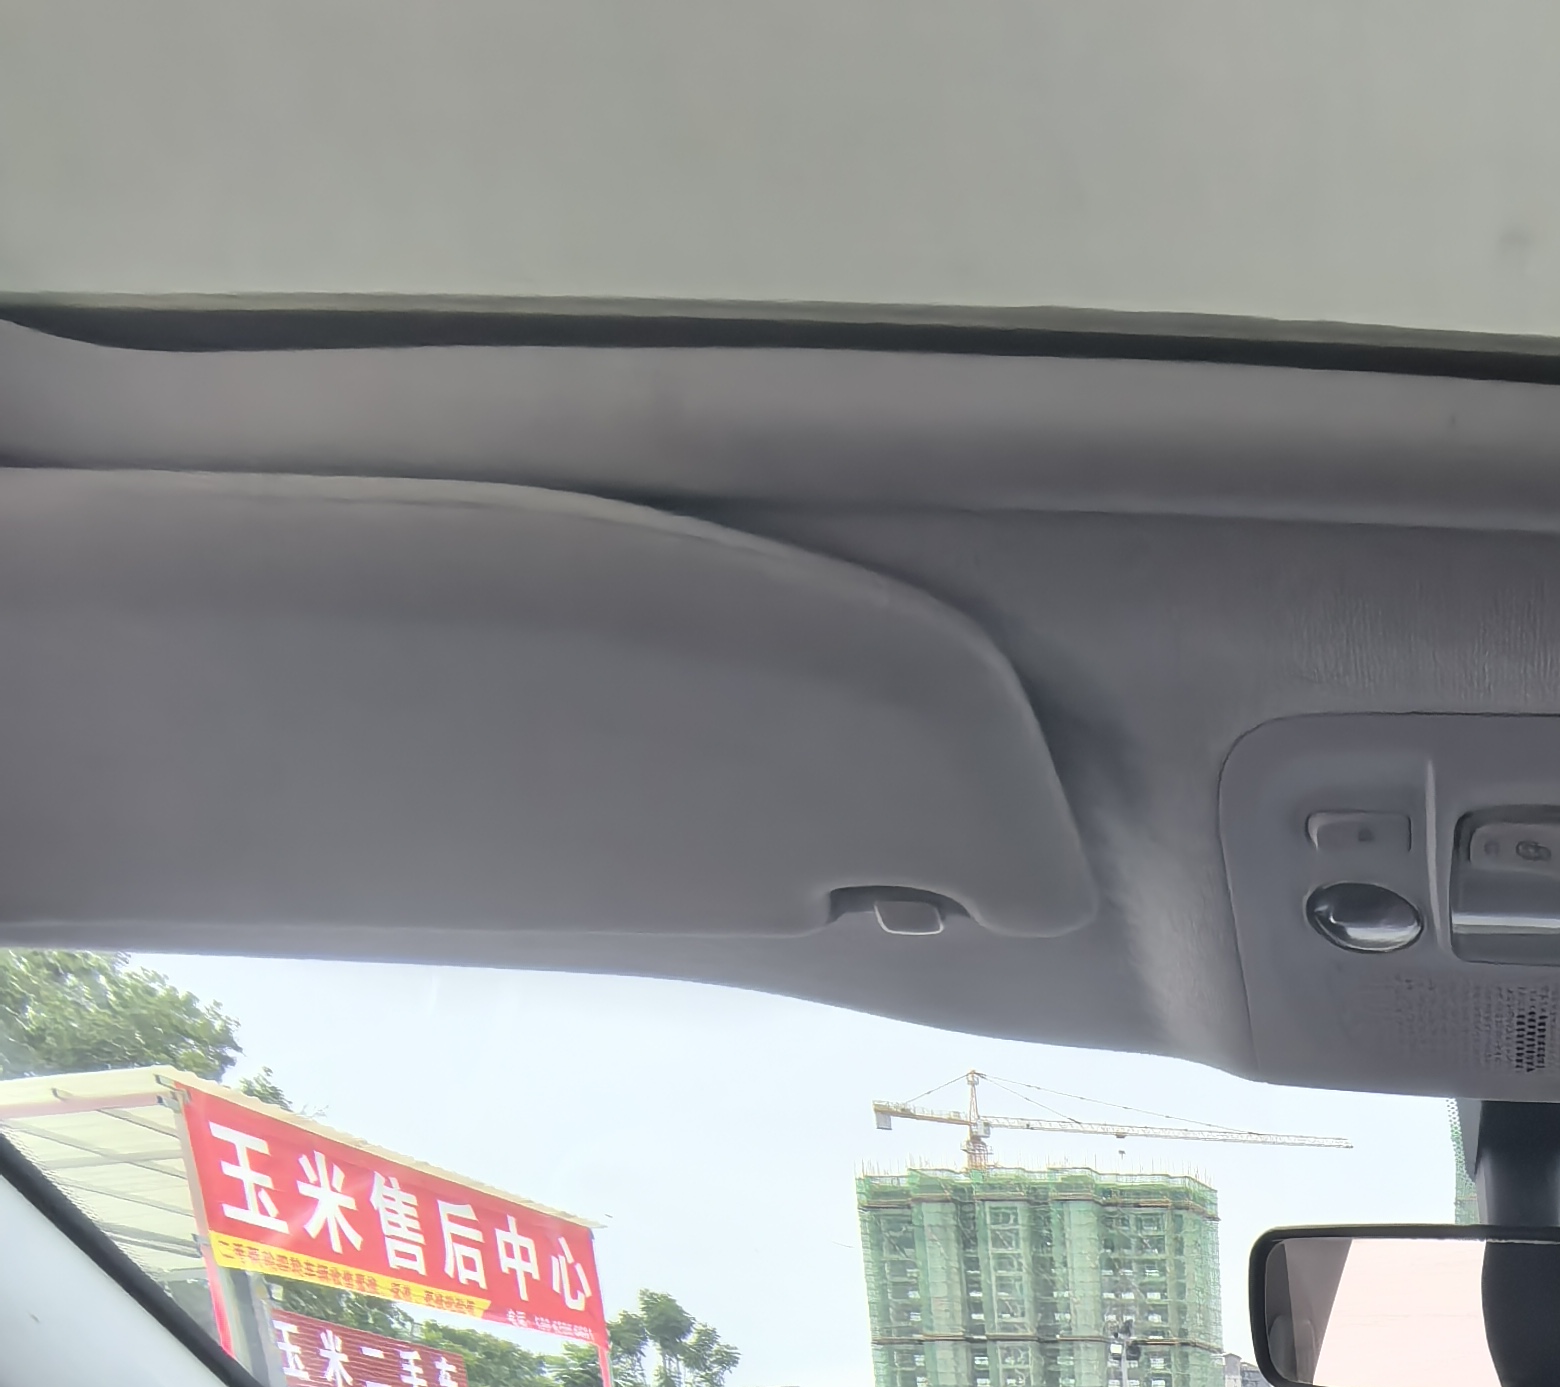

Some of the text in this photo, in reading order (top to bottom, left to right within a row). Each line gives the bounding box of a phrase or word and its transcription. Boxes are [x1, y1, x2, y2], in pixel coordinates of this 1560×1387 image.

[208, 1120, 593, 1312] 玉米售后中心
